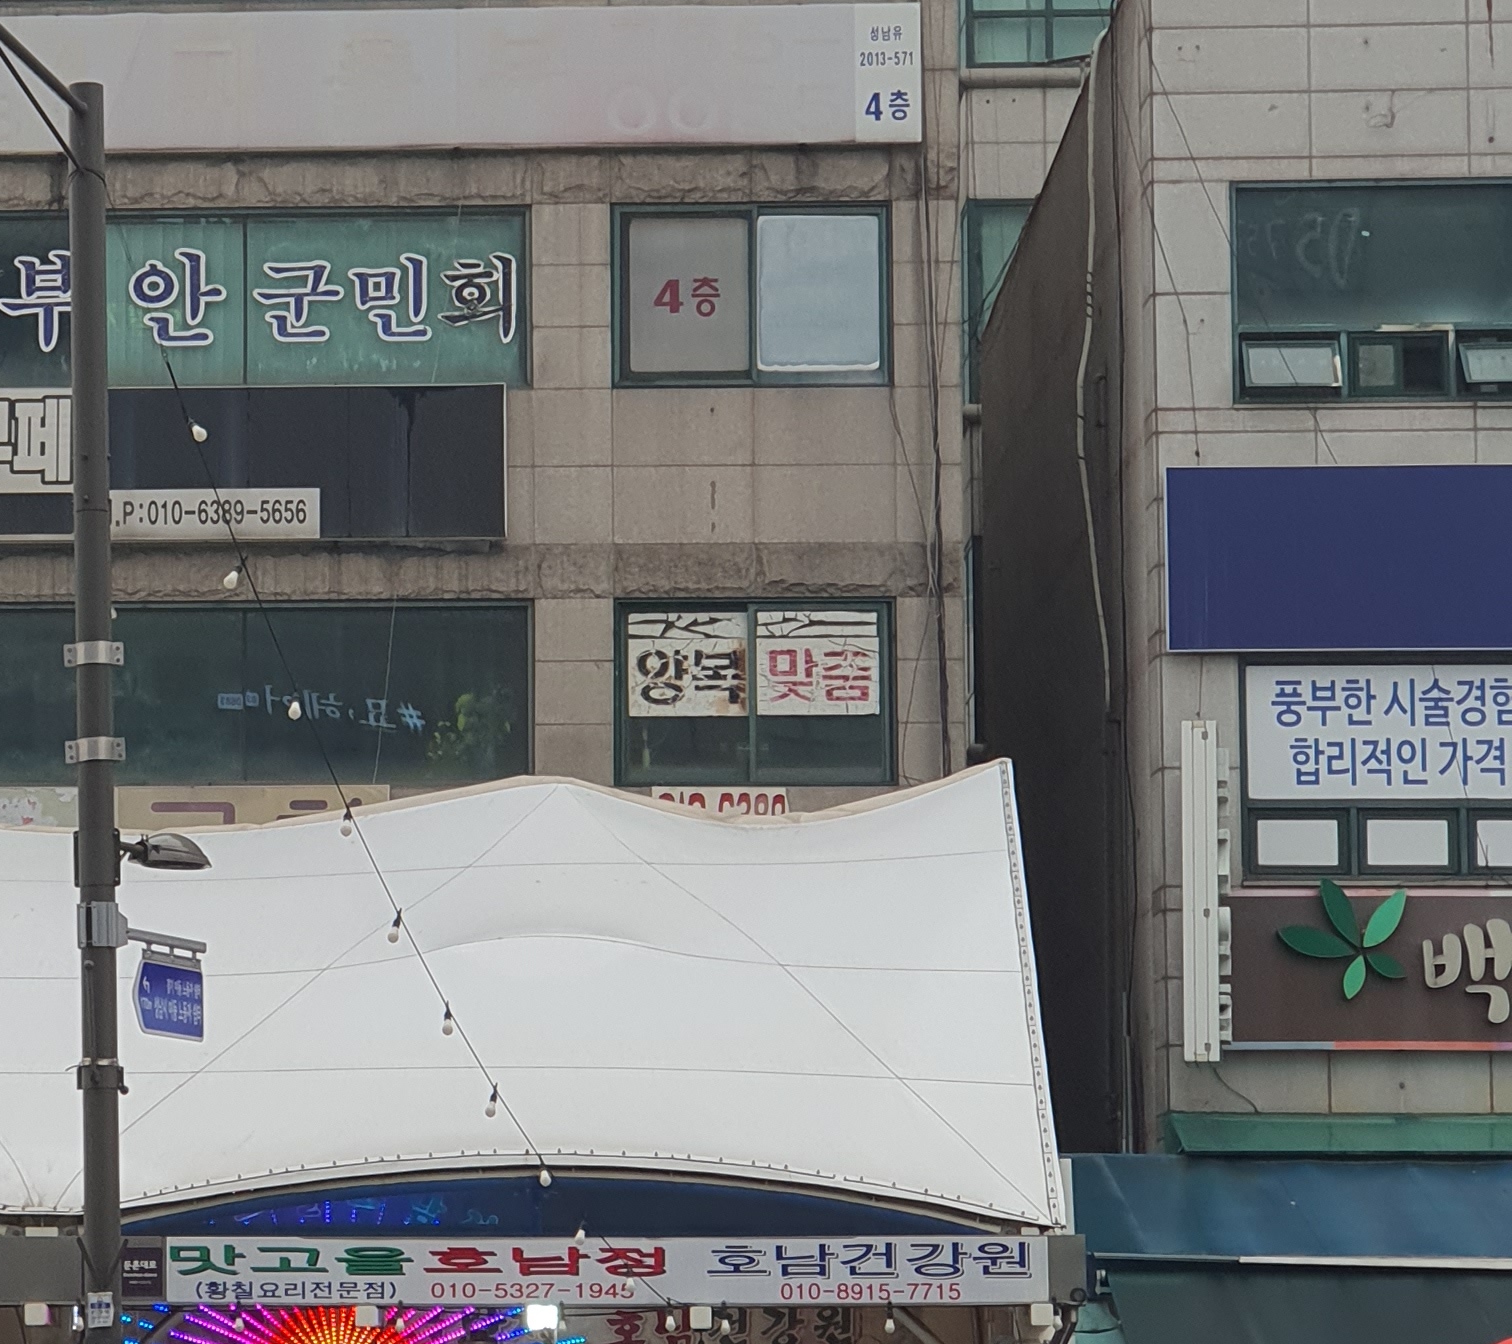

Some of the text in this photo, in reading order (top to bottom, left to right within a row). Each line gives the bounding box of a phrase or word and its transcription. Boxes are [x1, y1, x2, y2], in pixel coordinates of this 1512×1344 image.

[870, 26, 902, 41] 성남유
[859, 51, 914, 67] 2013-571
[864, 89, 911, 122] 4층
[653, 276, 721, 318] 4층
[109, 499, 308, 527] .P:010-6389-5656
[1270, 677, 1376, 728] 풍부한
[1290, 736, 1507, 787] 합리적인 가격
[169, 1243, 667, 1277] 맛고을 호남정
[706, 1241, 1033, 1280] 호남건강원
[194, 1279, 398, 1302] (황칠요리전문점)
[431, 1282, 635, 1299] 010-5327-1945
[780, 1282, 962, 1302] 010-8915-7715
